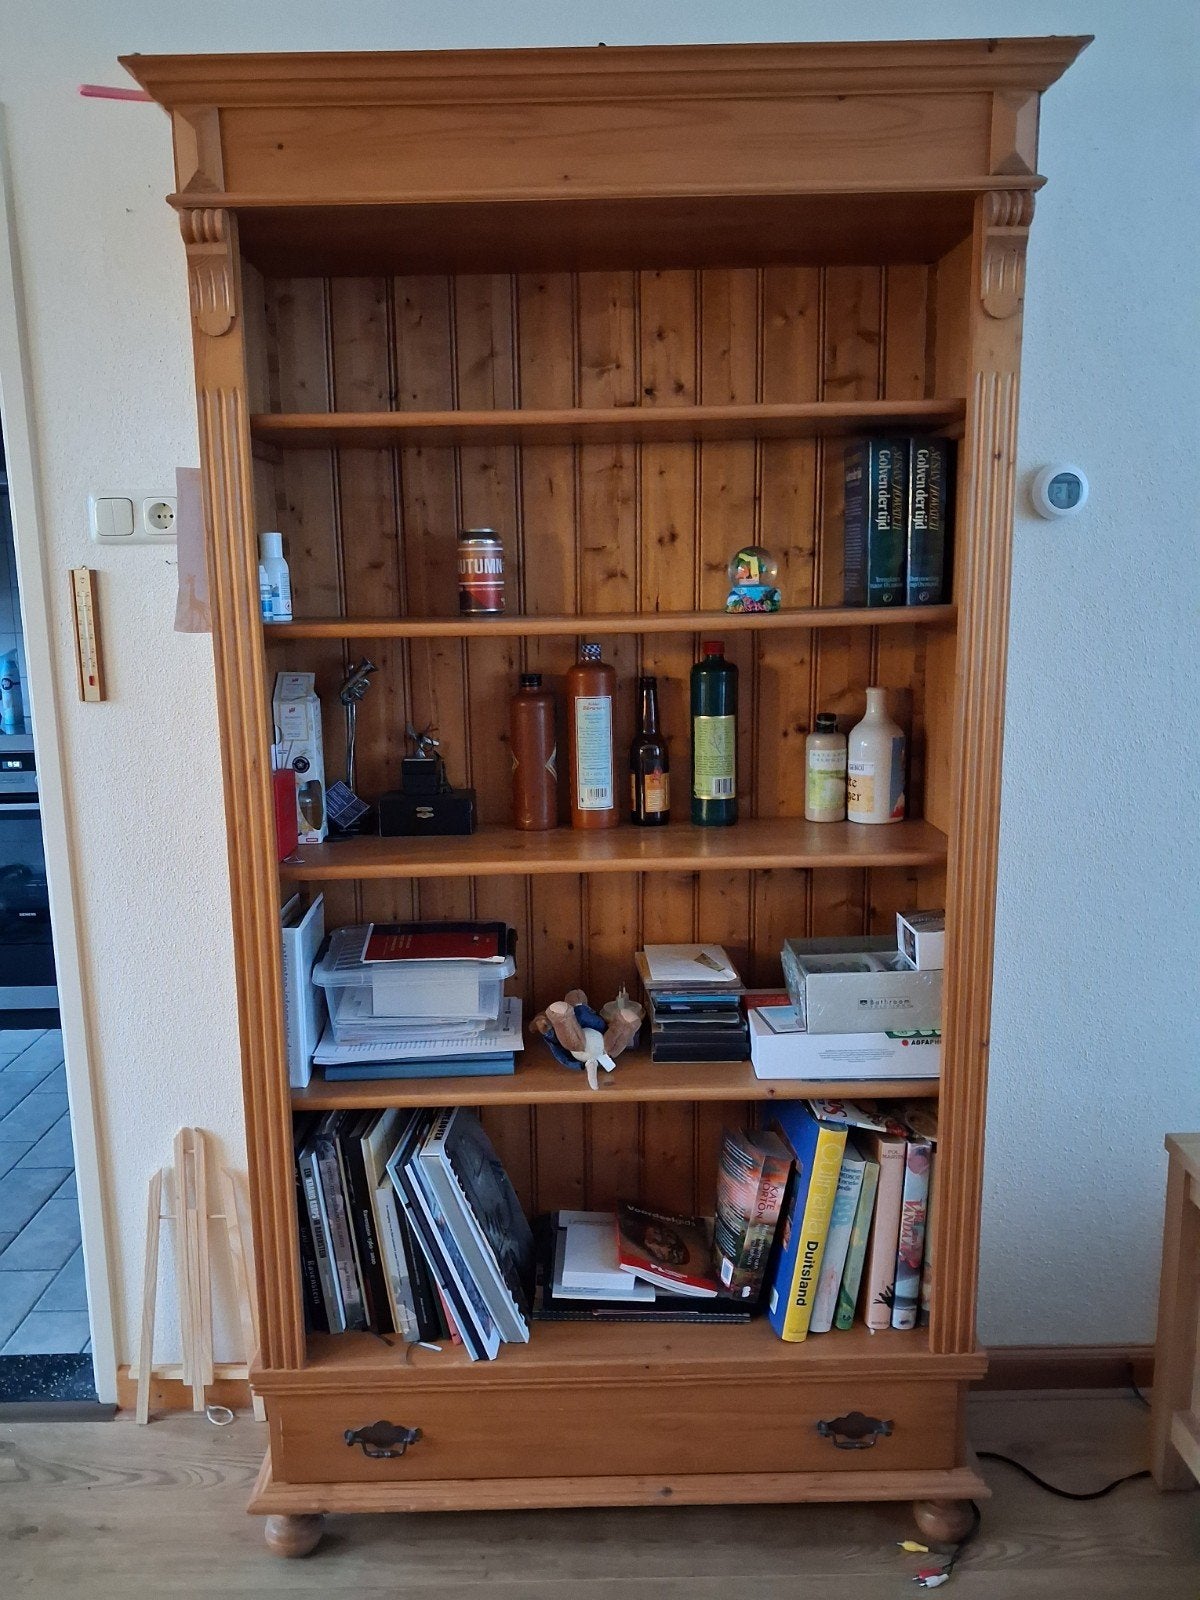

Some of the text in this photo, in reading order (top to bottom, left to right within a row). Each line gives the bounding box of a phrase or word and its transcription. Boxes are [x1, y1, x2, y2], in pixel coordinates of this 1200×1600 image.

[875, 449, 891, 530] Golven der tijd
[912, 449, 929, 530] Golven der tijd
[458, 558, 503, 574] UTUMN
[766, 1185, 779, 1211] KATE
[307, 1260, 321, 1304] Ravenstein
[796, 1240, 819, 1306] Duitsland
